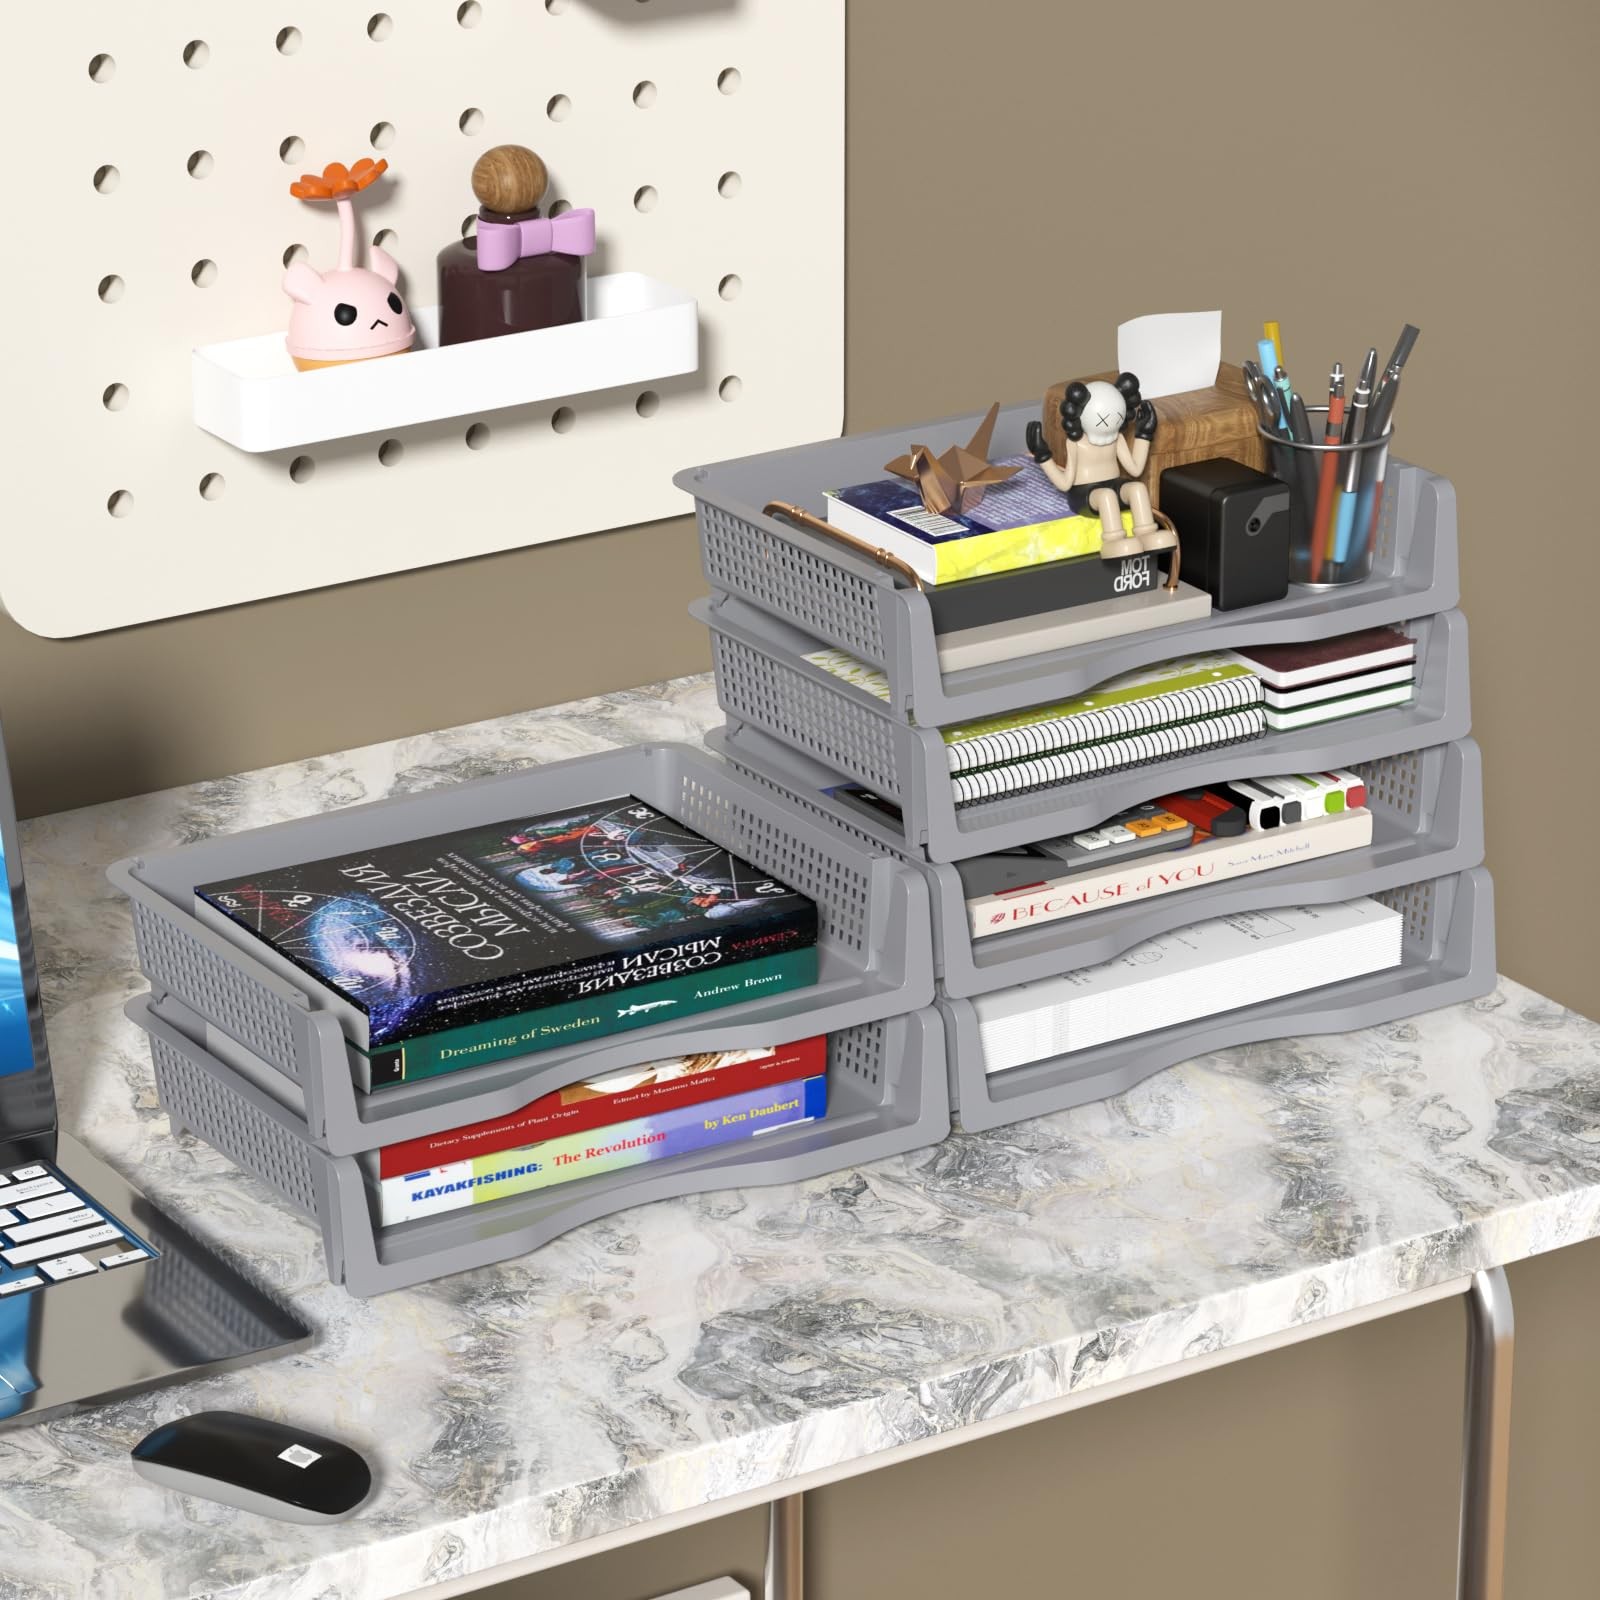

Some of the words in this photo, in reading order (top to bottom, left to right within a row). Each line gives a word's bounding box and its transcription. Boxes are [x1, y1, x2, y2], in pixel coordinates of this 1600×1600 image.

[338, 863, 504, 960] СОЗВЕЗДИЯ
[403, 868, 531, 937] МЫСЛИ
[1013, 882, 1129, 920] BECAUSE
[1136, 877, 1152, 892] of
[1158, 863, 1215, 885] YOU
[578, 951, 722, 994] СОЗВЕЗДИЯ
[622, 936, 722, 969] МЫСЛИ
[694, 982, 740, 999] Andrew
[744, 973, 783, 988] Brown
[440, 1036, 517, 1060] Dreaming
[521, 1028, 538, 1040] of
[540, 1015, 600, 1036] Sweden
[613, 1094, 639, 1105] Edited
[640, 1090, 651, 1099] by
[704, 1119, 719, 1130] by
[722, 1113, 746, 1125] Ken
[750, 1098, 800, 1118] Daubert
[429, 1137, 460, 1149] Dietary
[462, 1124, 515, 1140] Supplements
[517, 1120, 526, 1128] of
[528, 1115, 549, 1126] Plant
[551, 1108, 579, 1121] Origin
[553, 1152, 581, 1167] The
[585, 1131, 667, 1158] Revolution
[411, 1163, 543, 1202] KAYAKFISHING:
